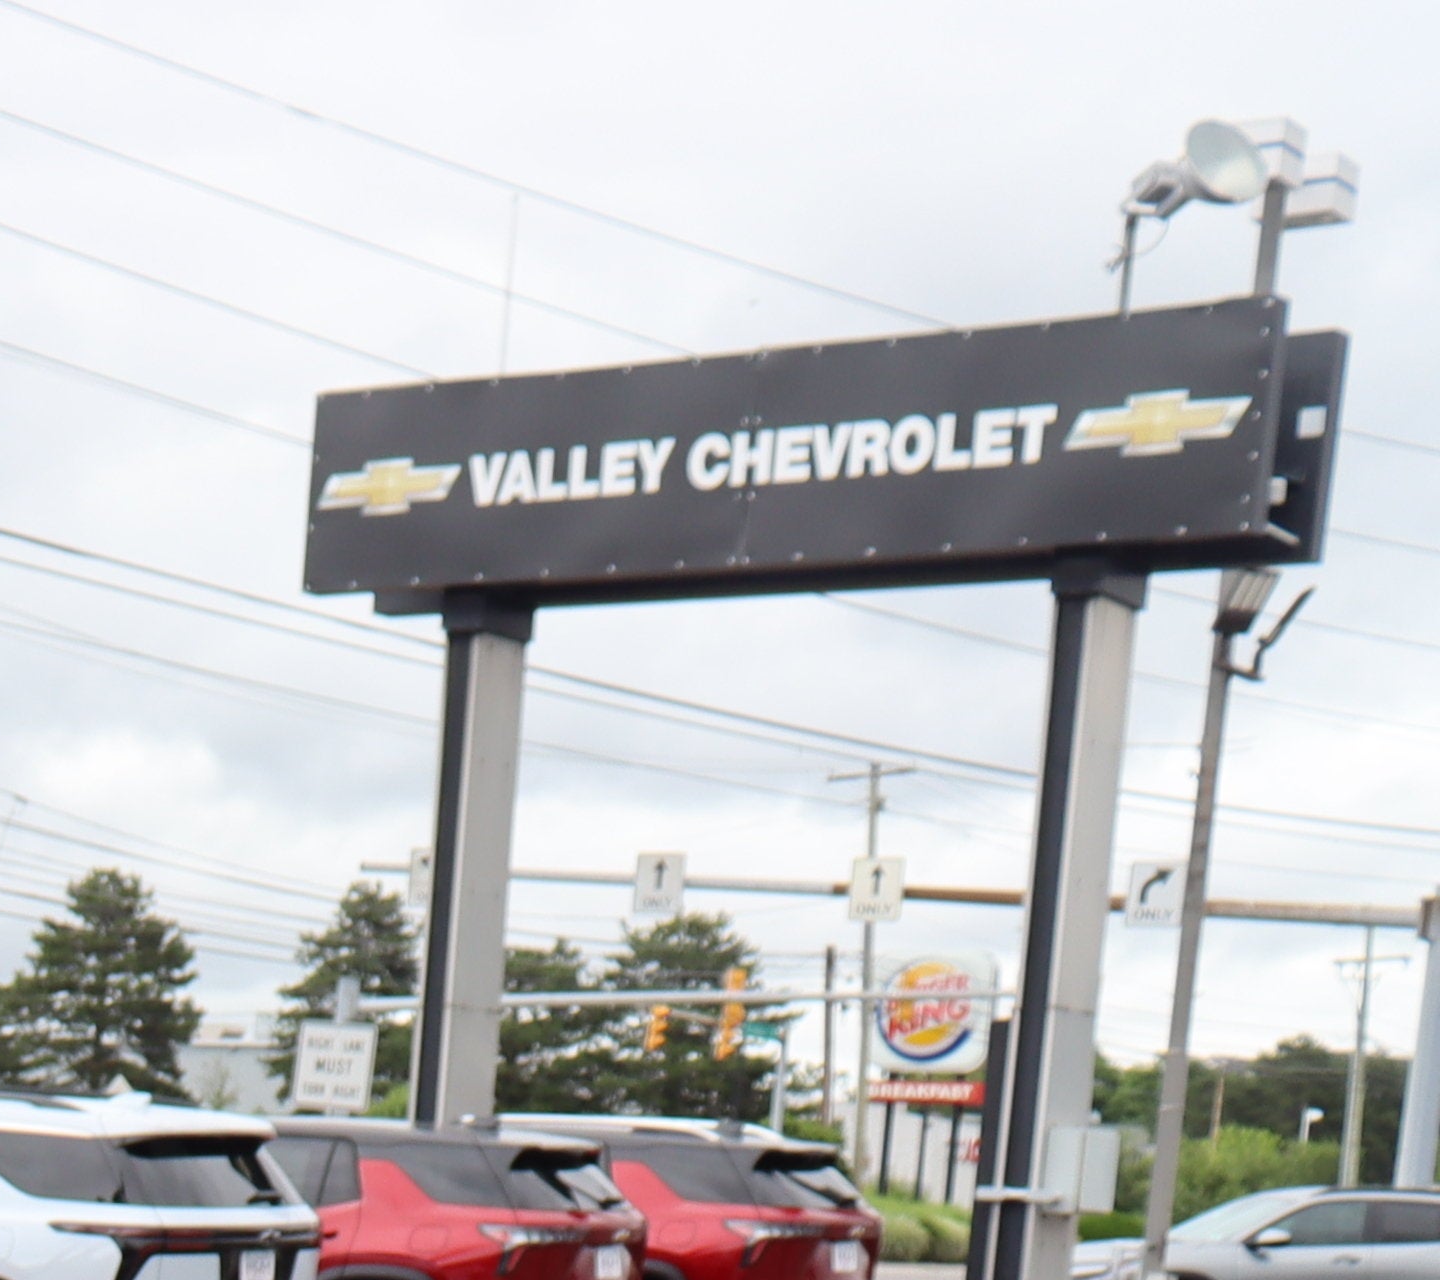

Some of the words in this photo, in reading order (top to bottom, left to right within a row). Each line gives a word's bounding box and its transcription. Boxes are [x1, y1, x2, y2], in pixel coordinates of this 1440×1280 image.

[468, 437, 674, 507] VALLEY
[686, 405, 1058, 490] CHEVROLET
[855, 902, 892, 916] ONLY
[1133, 908, 1174, 922] ONLY
[314, 1057, 353, 1075] MUST
[867, 1082, 976, 1100] BREAKFAST
